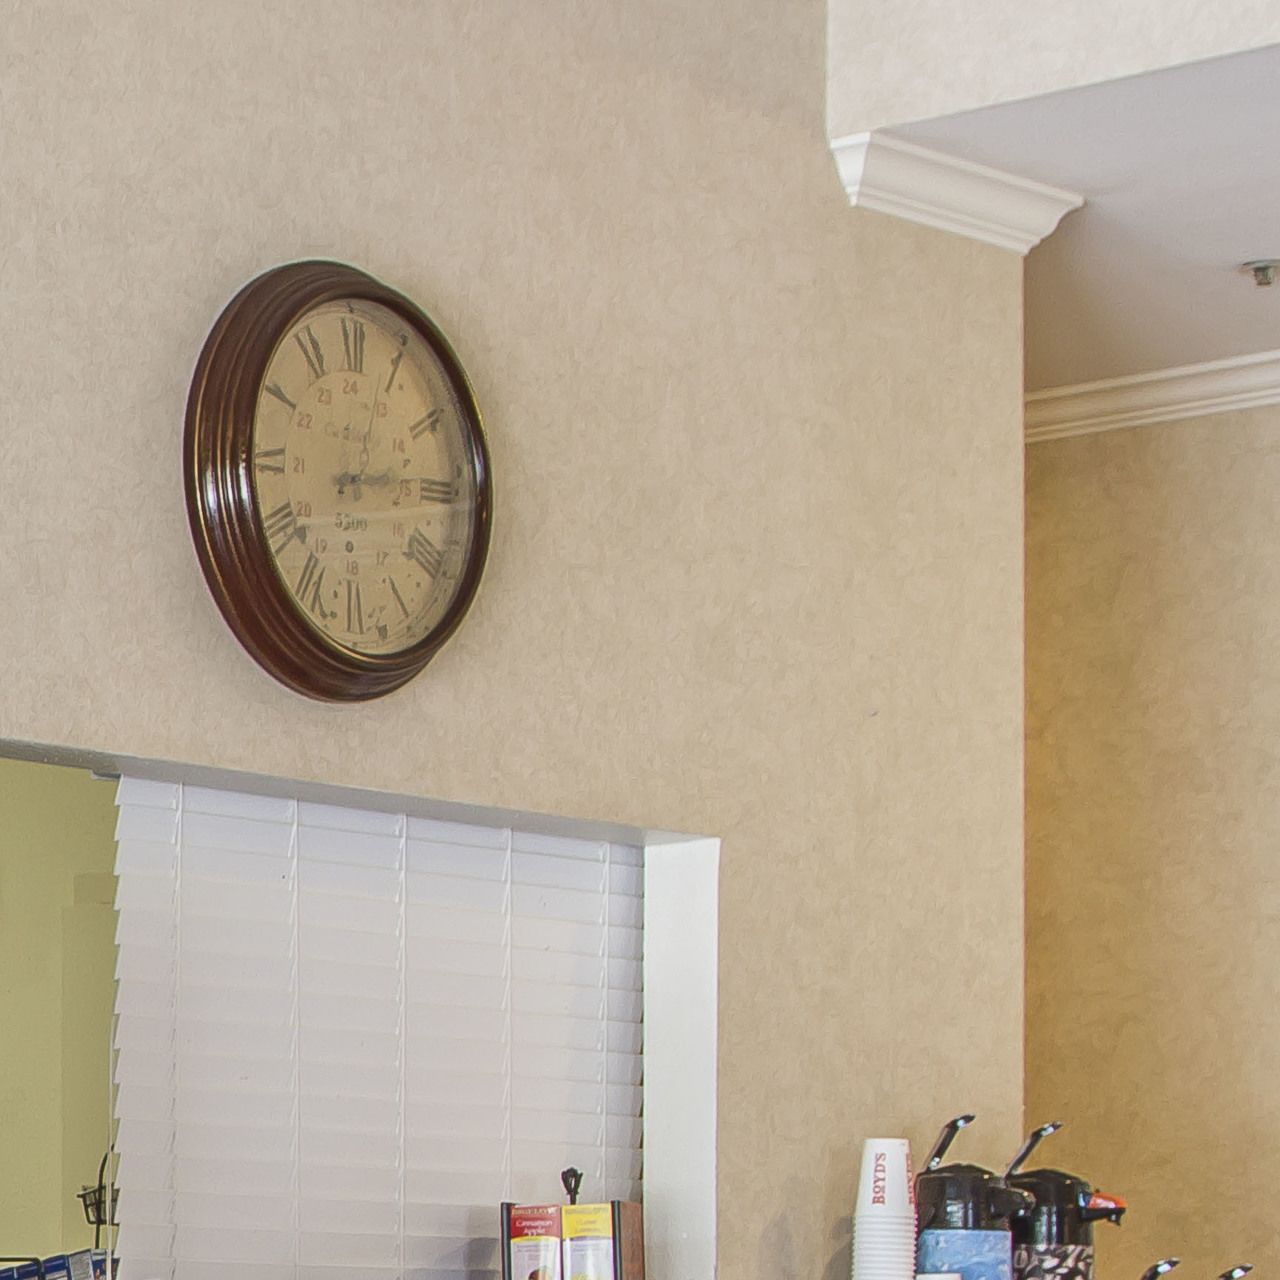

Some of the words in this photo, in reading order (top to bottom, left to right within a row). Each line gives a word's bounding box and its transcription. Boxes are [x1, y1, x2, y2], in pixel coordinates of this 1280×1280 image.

[293, 457, 306, 474] 21
[296, 501, 313, 518] 20
[345, 560, 359, 575] 18
